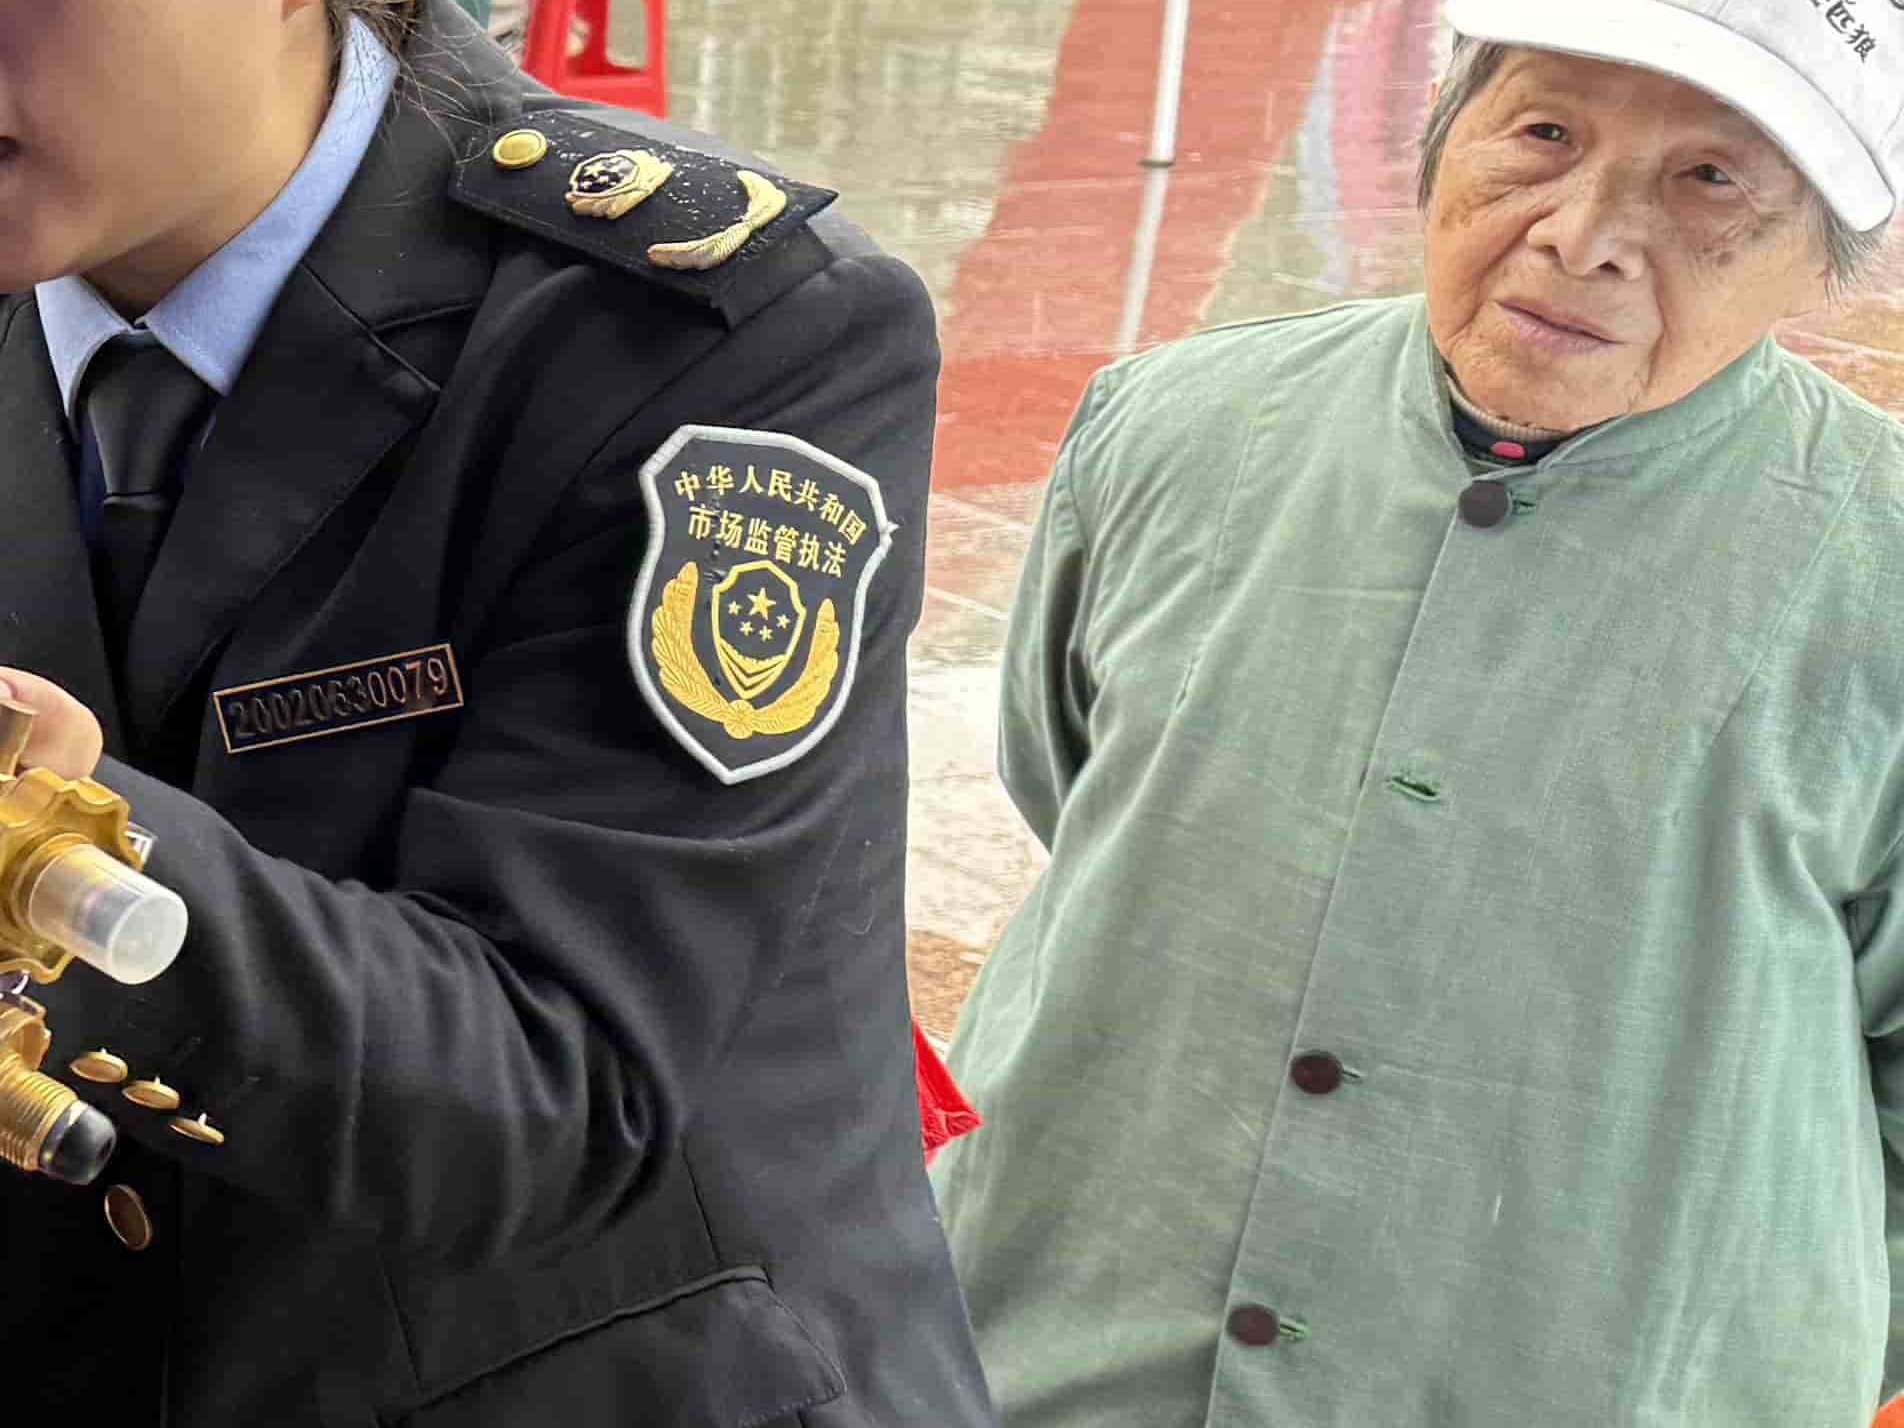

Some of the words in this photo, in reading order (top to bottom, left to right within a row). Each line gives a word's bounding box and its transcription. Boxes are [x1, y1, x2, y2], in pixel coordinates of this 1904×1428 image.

[673, 464, 869, 546] 中华人民共和国
[687, 503, 848, 579] 市场监管执法
